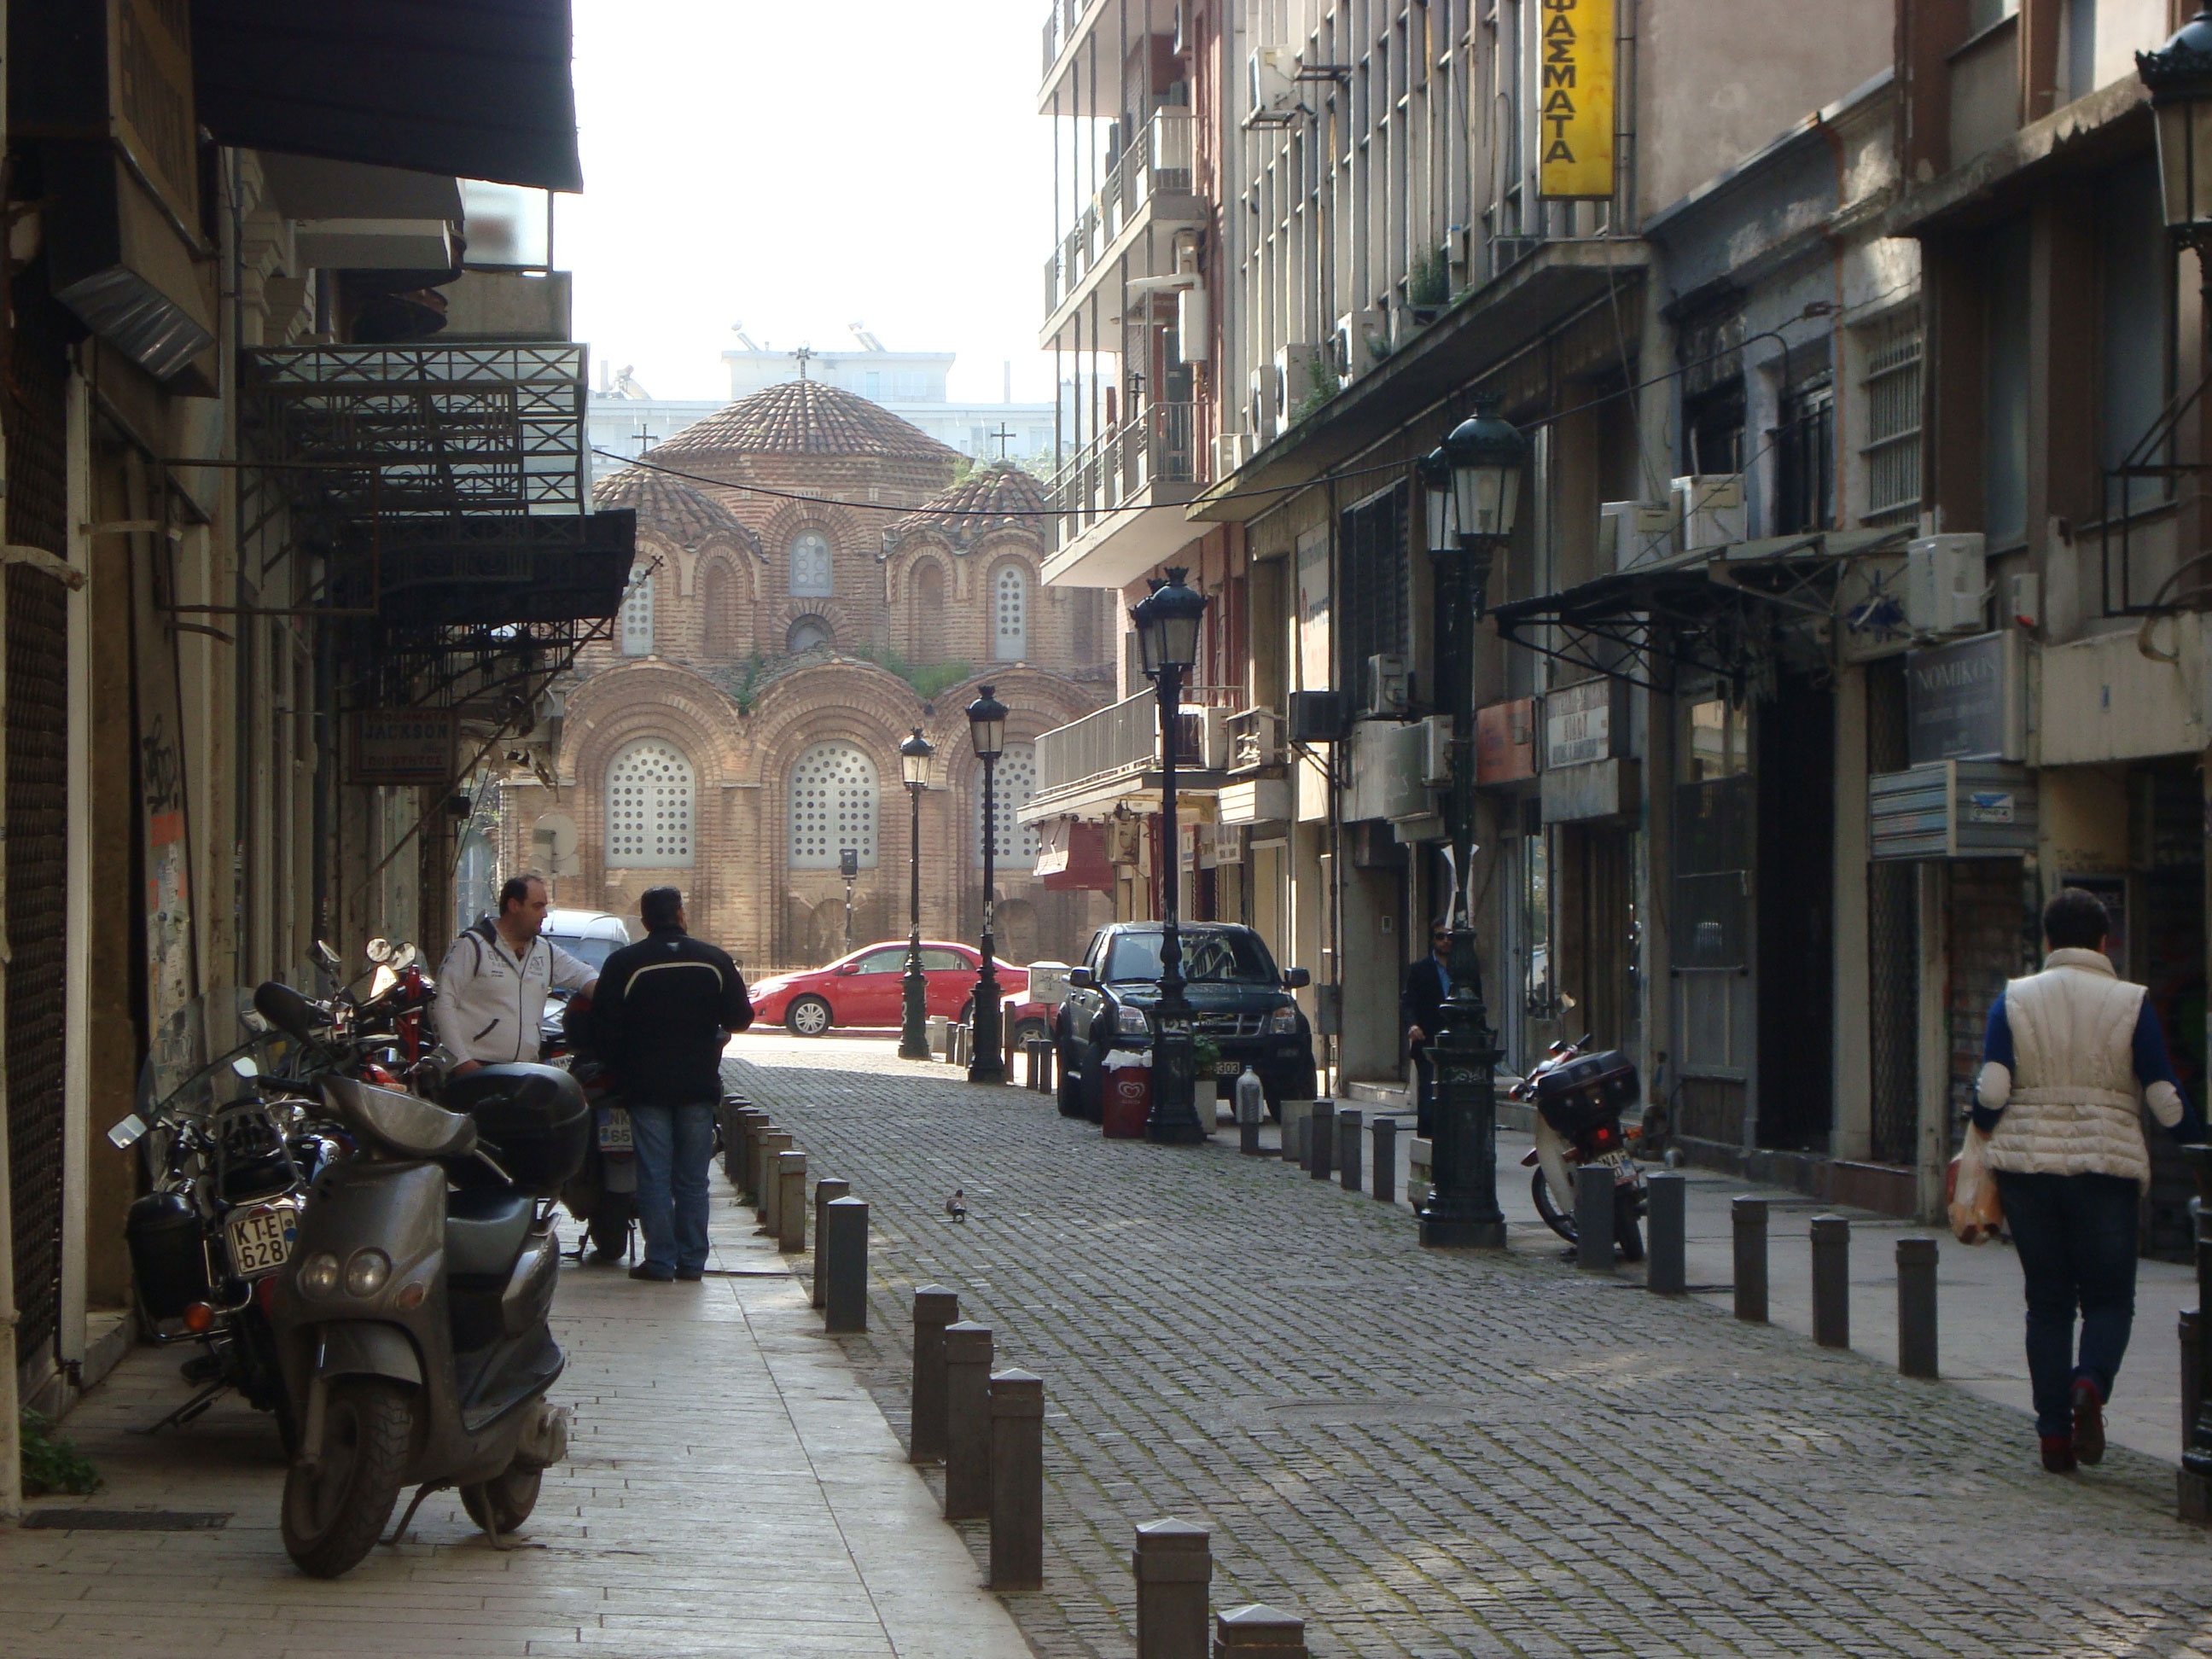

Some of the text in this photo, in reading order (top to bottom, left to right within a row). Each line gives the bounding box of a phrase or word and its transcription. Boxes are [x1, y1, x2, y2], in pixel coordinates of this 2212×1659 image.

[364, 723, 447, 740] JACKSON
[235, 1215, 279, 1245] KTE
[242, 1240, 284, 1268] 628
